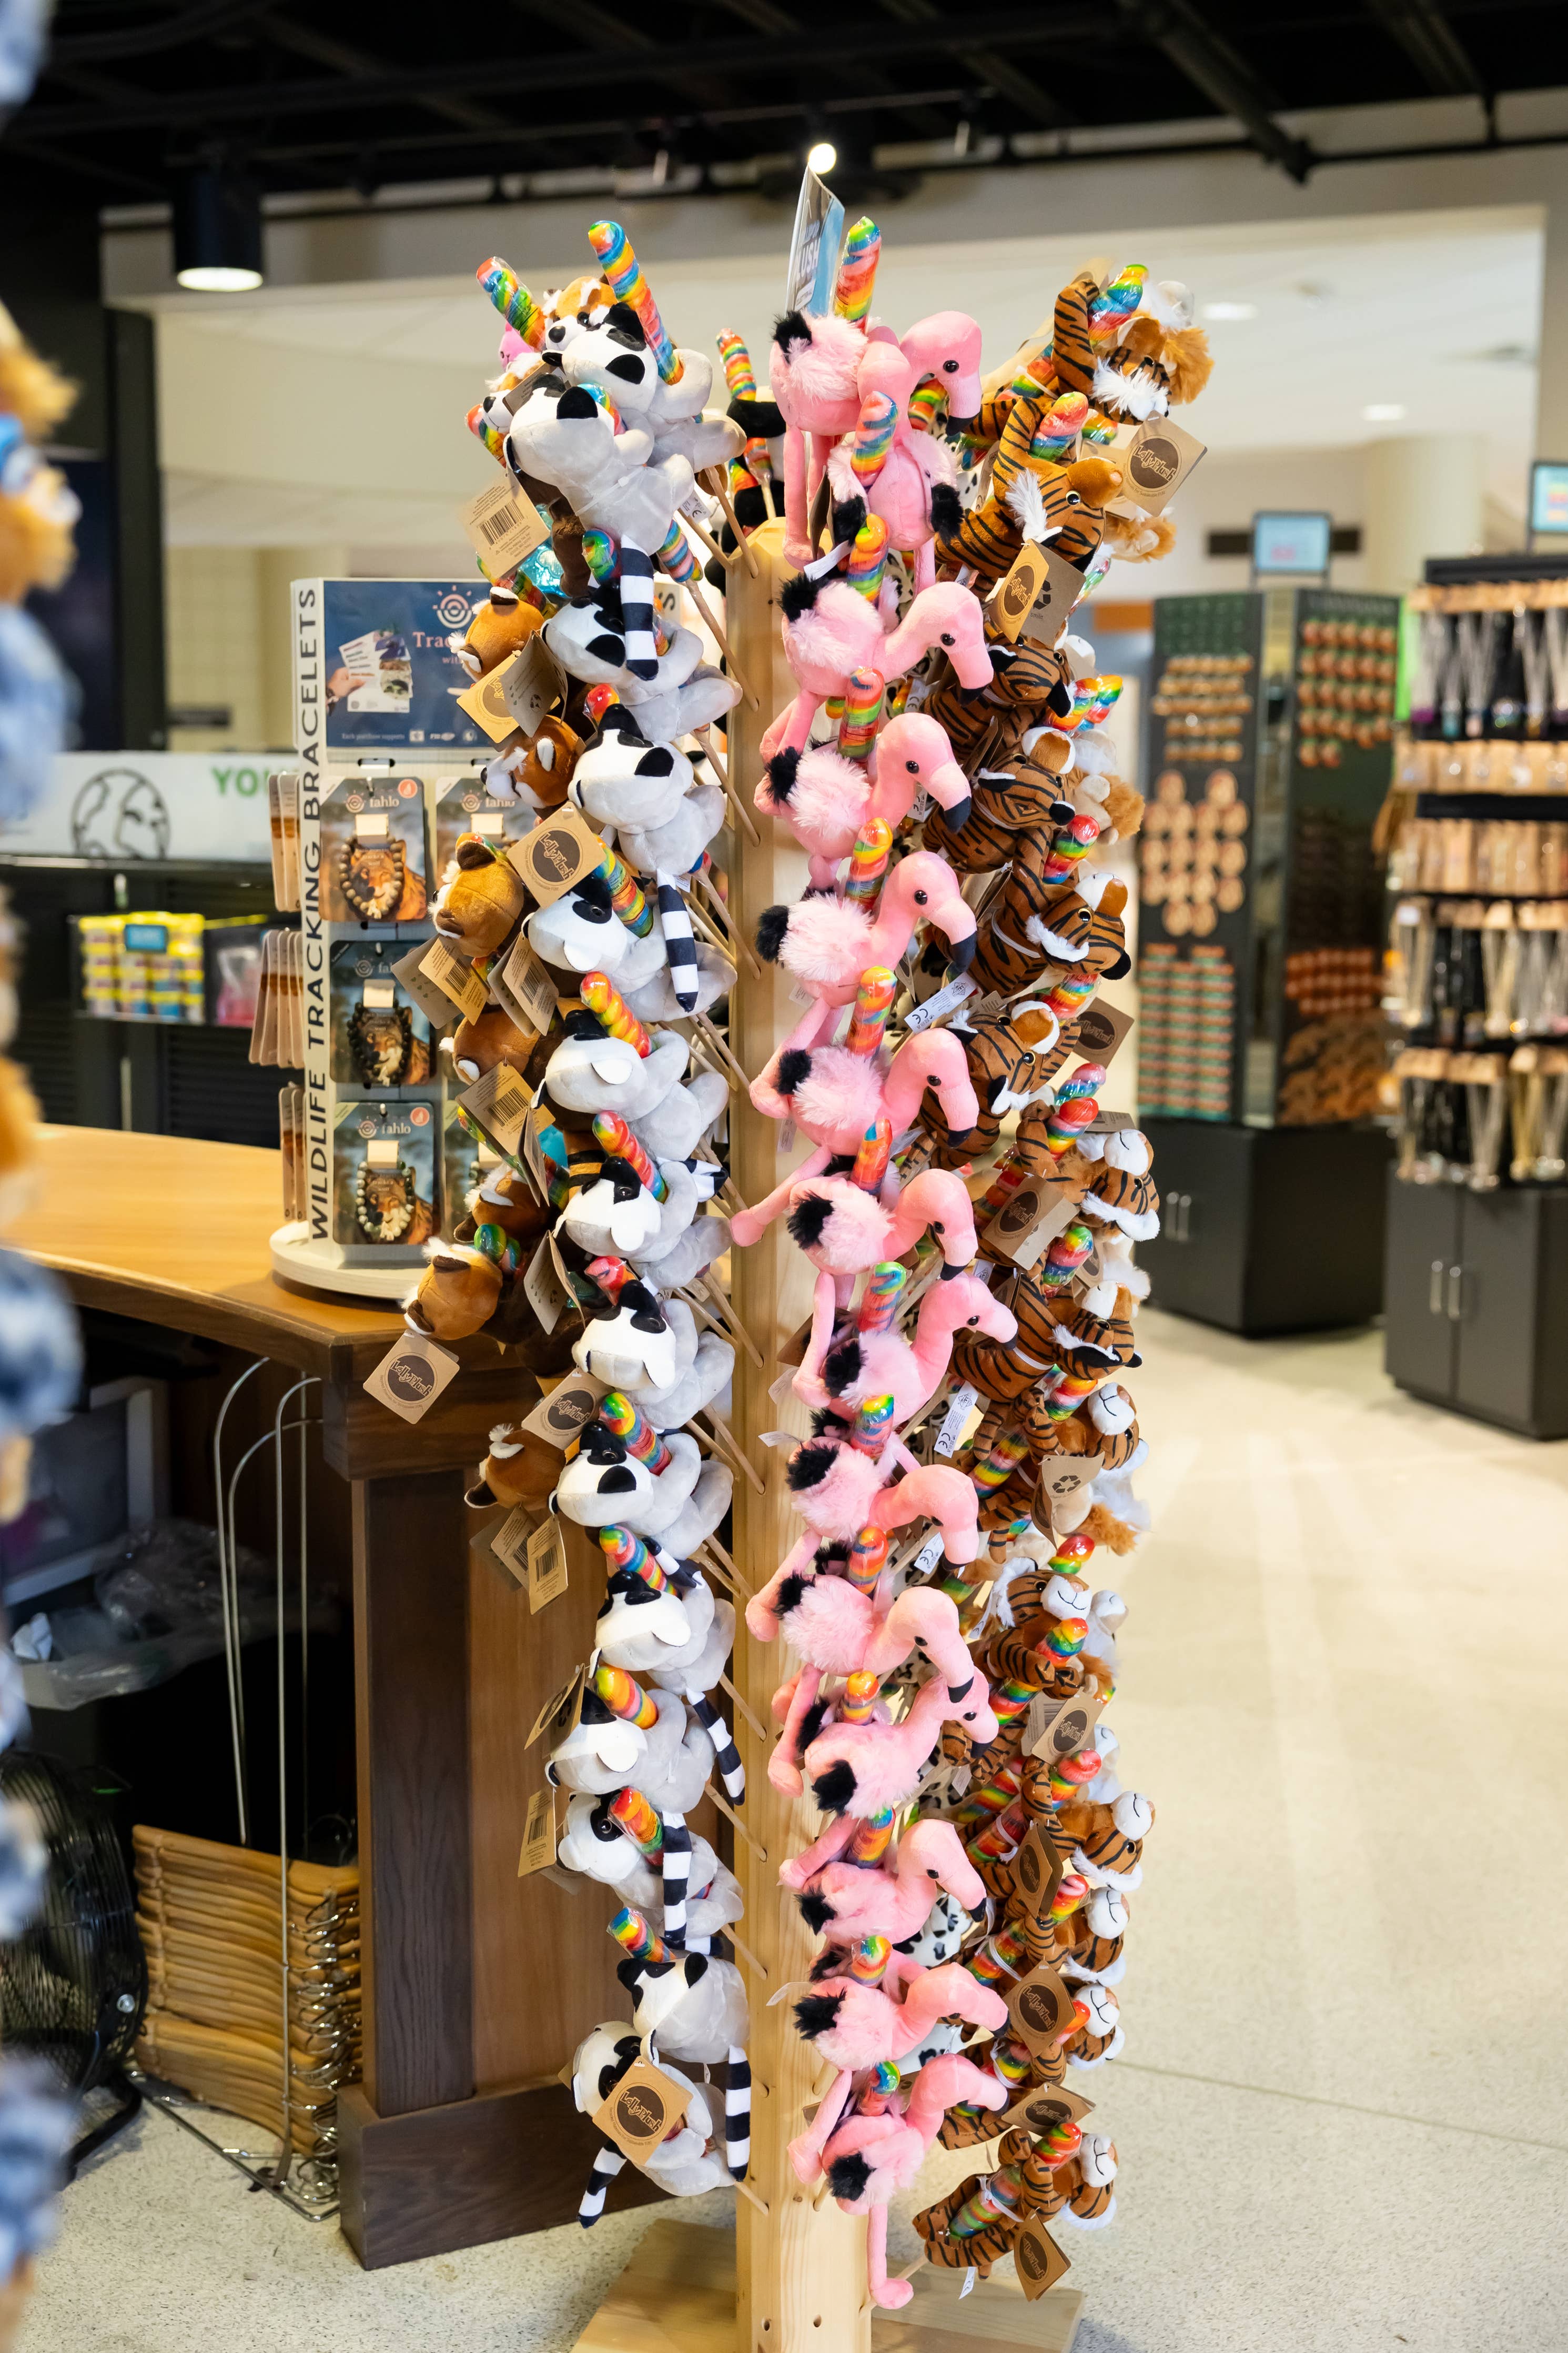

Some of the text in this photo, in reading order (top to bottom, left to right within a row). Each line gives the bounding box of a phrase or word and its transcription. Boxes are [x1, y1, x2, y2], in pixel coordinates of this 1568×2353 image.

[539, 833, 575, 880] LollyPlush
[299, 588, 329, 1240] WILDLIFE TRACKING BRACELETS
[390, 1360, 432, 1396] LollyPlush
[620, 2090, 662, 2133] LollyPlush
